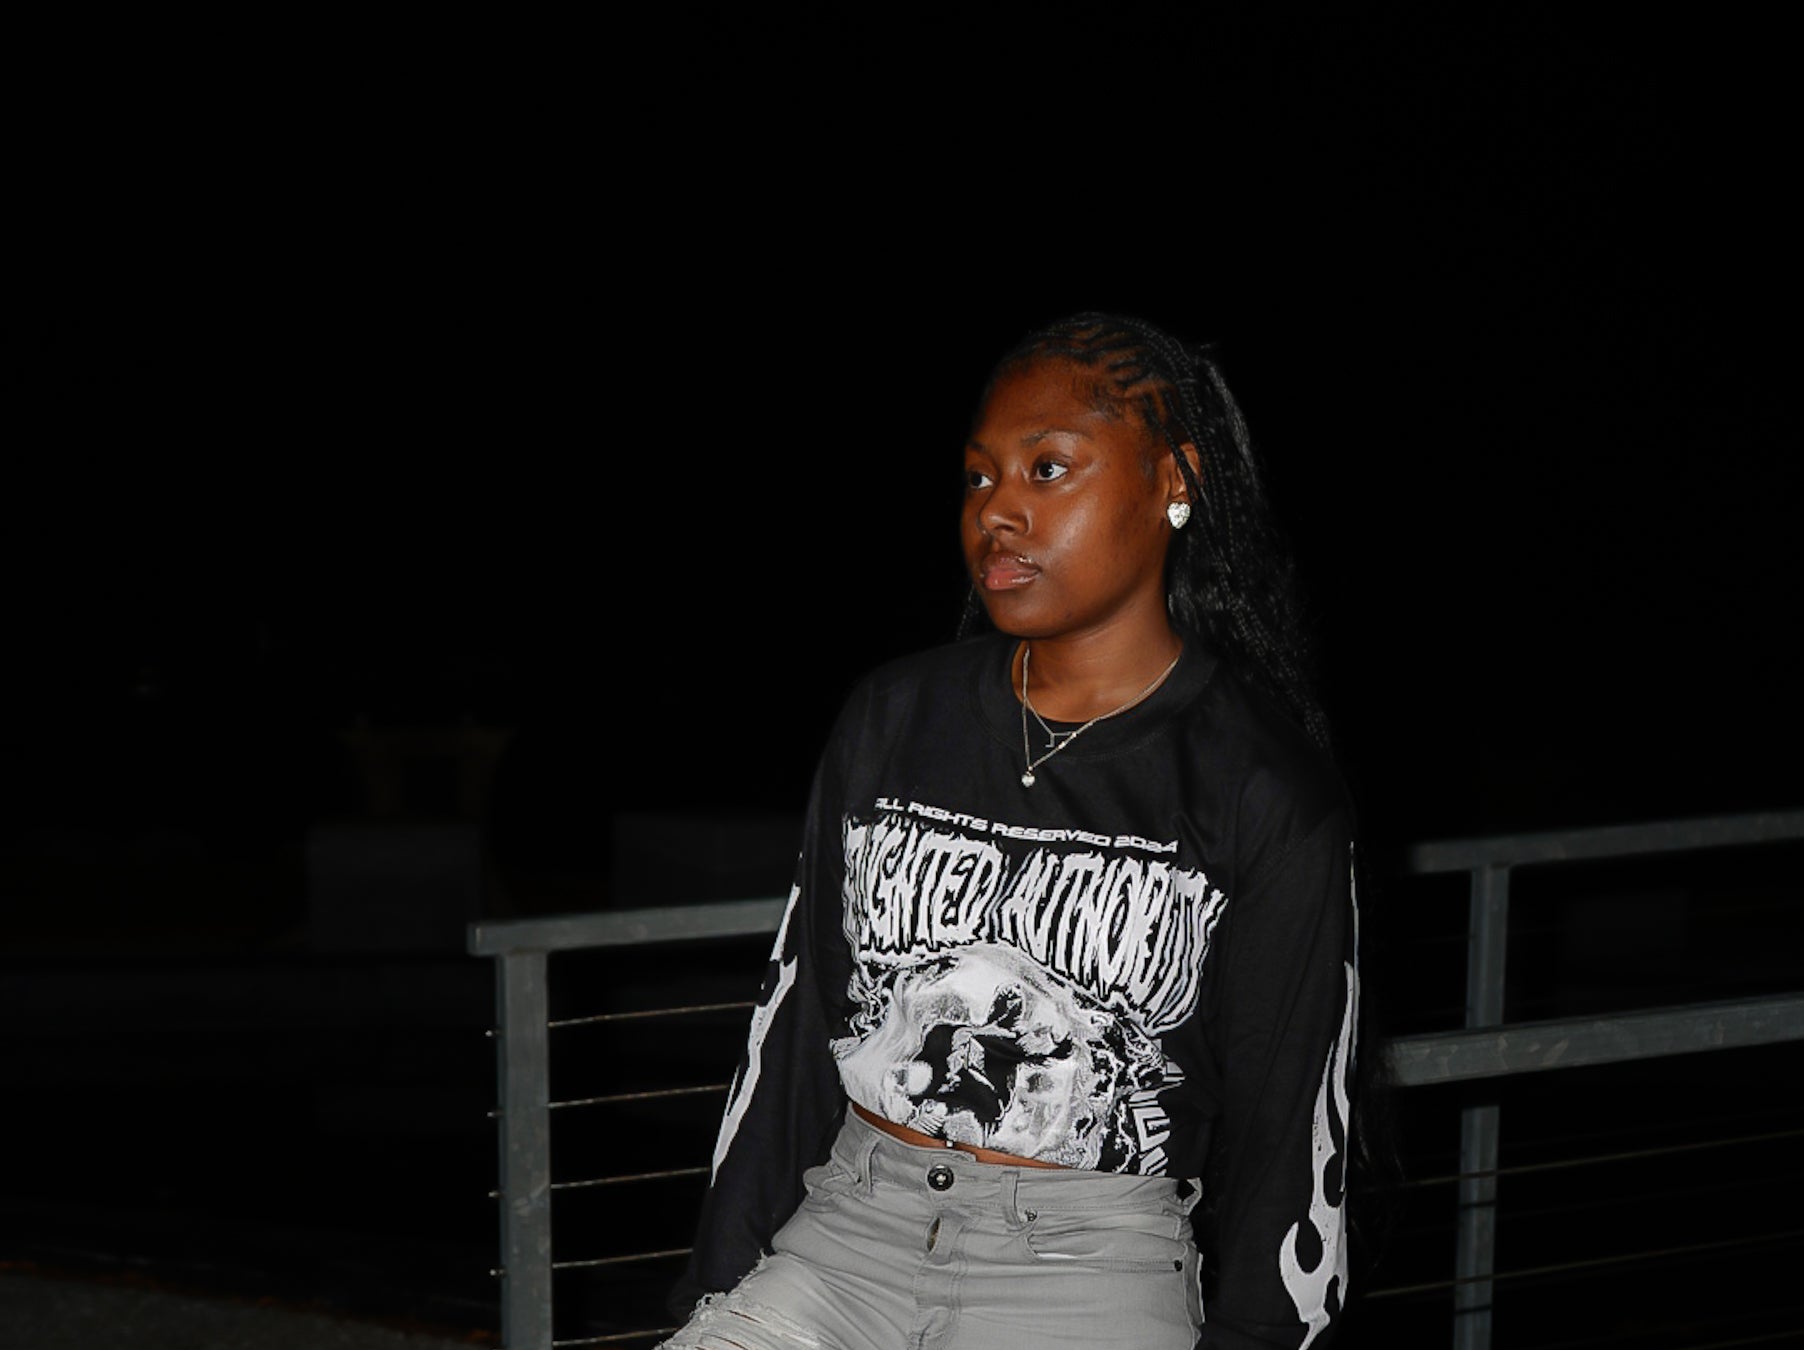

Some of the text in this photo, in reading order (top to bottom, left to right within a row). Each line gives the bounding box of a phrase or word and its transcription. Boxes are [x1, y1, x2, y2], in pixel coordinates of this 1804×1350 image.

[907, 801, 988, 831] RIGHTS
[991, 822, 1112, 847] RESERVED
[1113, 834, 1179, 853] 2024
